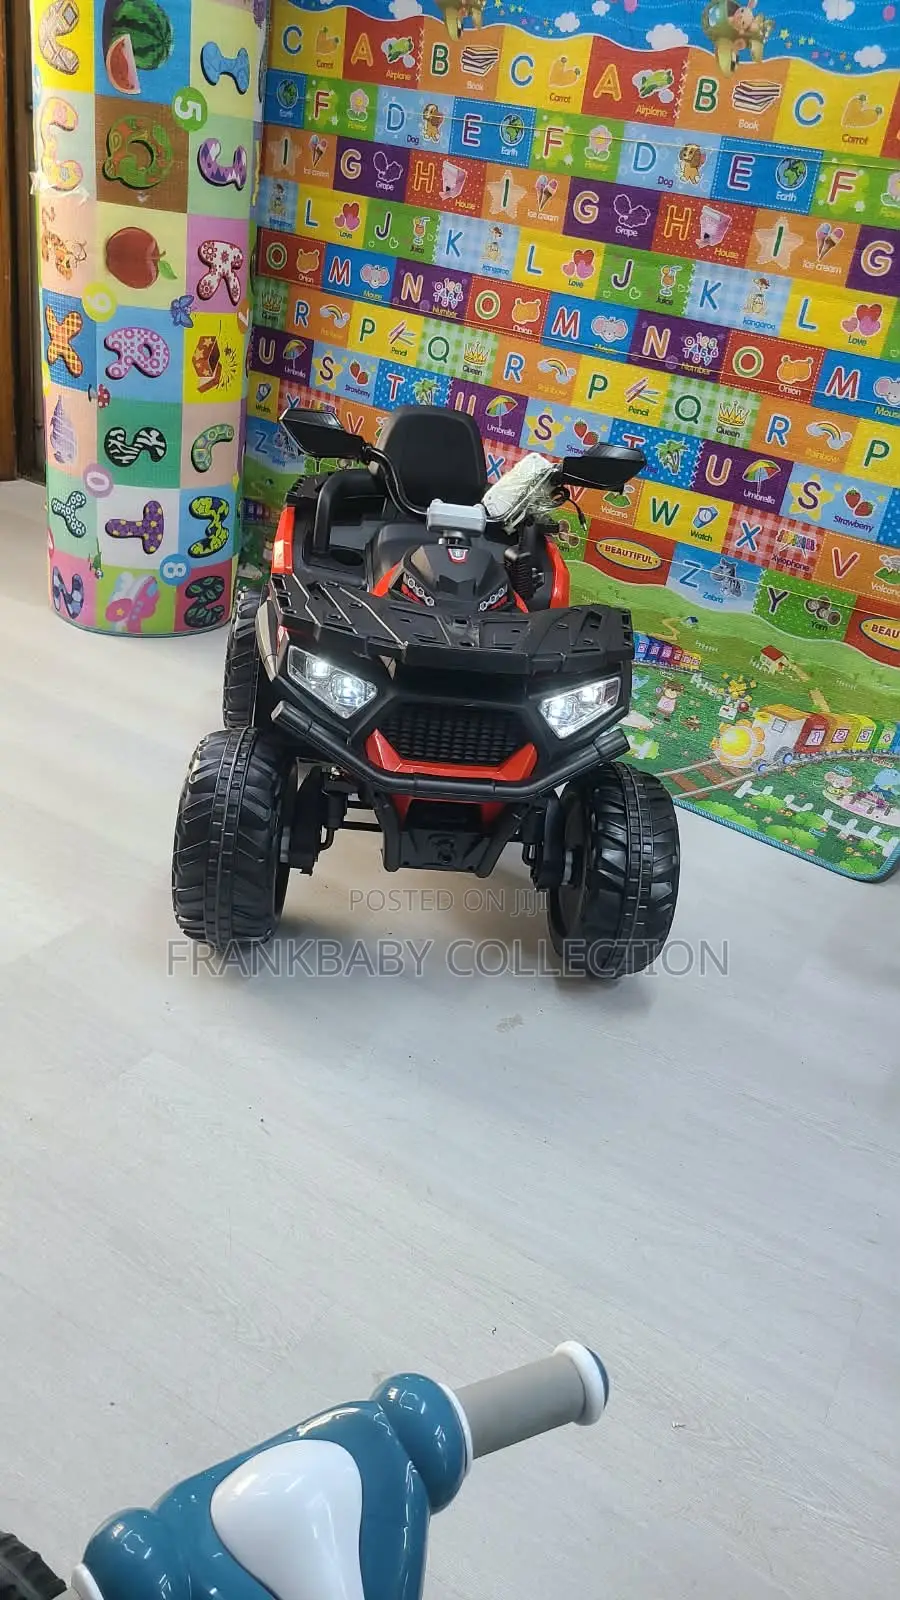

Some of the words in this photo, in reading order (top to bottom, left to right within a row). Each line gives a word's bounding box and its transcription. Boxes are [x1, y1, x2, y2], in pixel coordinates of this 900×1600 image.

[282, 25, 303, 55] C
[351, 32, 374, 67] A
[431, 41, 449, 77] B
[509, 52, 535, 88] C
[466, 80, 484, 92] Book
[593, 63, 622, 101] A
[693, 76, 719, 114] B
[174, 96, 202, 122] 5
[313, 89, 330, 120] F
[549, 92, 571, 104] Carrot
[635, 104, 668, 118] Airplane
[793, 90, 825, 128] C
[386, 101, 406, 134] D
[461, 112, 483, 148] E
[738, 119, 761, 131] Book
[282, 137, 289, 167] I
[406, 134, 420, 145] Dog
[501, 146, 518, 157] Earth
[542, 126, 565, 159] F
[842, 133, 869, 146] Carrot
[197, 138, 248, 191] J
[340, 148, 362, 180] G
[631, 139, 657, 174] D
[375, 181, 394, 192] Grape
[413, 160, 435, 193] H
[657, 175, 674, 188] Dog
[727, 153, 756, 192] E
[827, 168, 858, 206] F
[455, 199, 476, 210] House
[501, 176, 512, 209] I
[573, 190, 600, 224] G
[775, 191, 798, 203] Earth
[304, 197, 320, 229] L
[374, 211, 393, 241] J
[664, 204, 691, 241] H
[445, 228, 464, 258] K
[615, 225, 638, 238] Grape
[772, 224, 785, 258] I
[266, 242, 288, 271] O
[525, 244, 544, 276] L
[714, 247, 739, 259] House
[860, 240, 895, 277] G
[197, 240, 244, 306] K
[298, 273, 314, 284] Onion
[328, 255, 351, 287] M
[568, 278, 584, 289] Love
[612, 258, 634, 291] J
[815, 262, 842, 275] cream
[87, 293, 111, 310] 9
[401, 272, 424, 304] N
[656, 296, 674, 306] Juice
[699, 278, 722, 312] K
[294, 299, 310, 329] R
[475, 289, 501, 321] O
[797, 297, 818, 332] L
[359, 316, 376, 343] P
[551, 305, 580, 340] M
[742, 317, 776, 331] kangaroo
[45, 303, 84, 378] X
[104, 327, 170, 380] R
[258, 336, 276, 365] U
[427, 335, 450, 364] Q
[642, 325, 671, 359] N
[848, 335, 868, 347] Love
[319, 355, 335, 382] S
[462, 364, 483, 376] Queen
[503, 352, 526, 384] R
[732, 345, 764, 379] O
[387, 373, 404, 401] T
[587, 373, 609, 401] P
[779, 384, 801, 396] Onion
[825, 365, 861, 401] M
[346, 412, 364, 436] V
[628, 405, 650, 417] Pencil
[674, 394, 702, 425] Q
[254, 430, 268, 454] Z
[487, 423, 516, 438] Umbrella
[534, 413, 554, 441] S
[716, 426, 740, 439] Queen
[765, 412, 792, 447] R
[104, 427, 168, 467] S
[863, 438, 891, 468] P
[486, 452, 506, 481] X
[705, 454, 732, 486] U
[743, 488, 775, 505] Umbrella
[797, 480, 822, 511] S
[51, 491, 86, 538] Y
[188, 495, 230, 558] M
[601, 505, 628, 519] Volcano
[651, 496, 680, 527] W
[833, 515, 875, 533] Strawberry
[105, 500, 165, 554] T
[690, 529, 713, 543] Watch
[735, 520, 762, 552] X
[163, 562, 187, 578] 8
[604, 545, 654, 565] BEAUTIFUL
[771, 553, 810, 573] Xylophone
[832, 547, 860, 579] V
[679, 559, 702, 589] Z
[702, 591, 724, 604] Zebra
[767, 585, 790, 615] Y
[811, 621, 828, 632] Yarn
